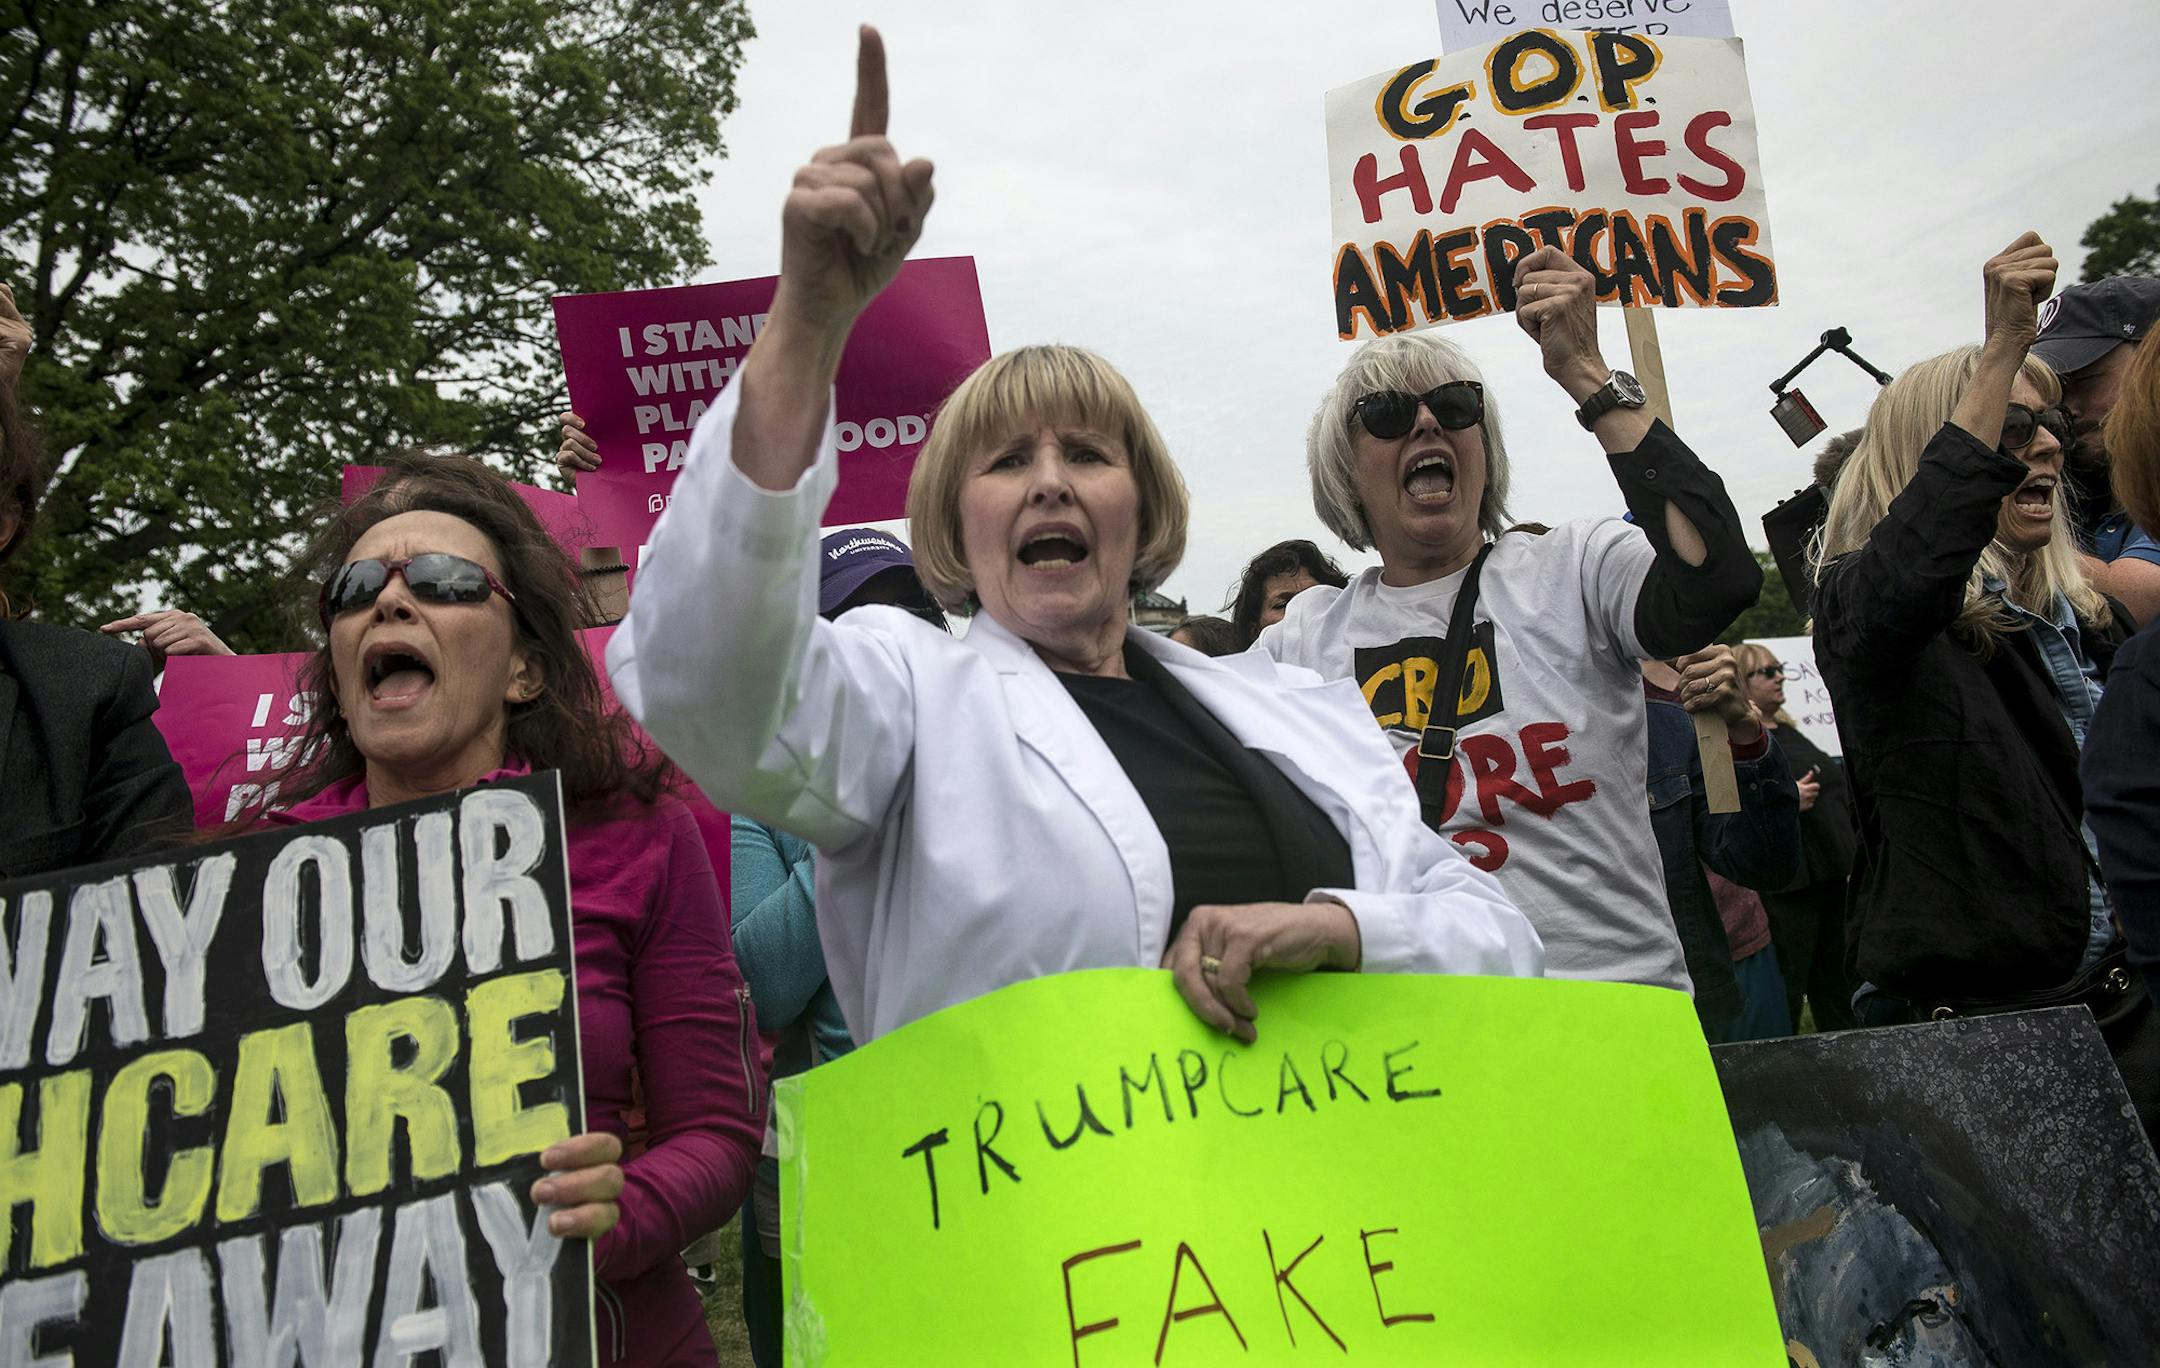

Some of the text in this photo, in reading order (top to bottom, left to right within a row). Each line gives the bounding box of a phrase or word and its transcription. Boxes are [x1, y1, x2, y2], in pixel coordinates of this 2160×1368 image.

[1456, 0, 1693, 25] We deserve
[1353, 110, 1746, 224] HATES
[619, 327, 634, 358] I
[626, 357, 738, 396] WITH
[634, 399, 709, 435] PLA
[642, 415, 927, 473] PA OOD
[828, 537, 904, 560] Northwestern
[251, 691, 319, 728] I S
[1403, 721, 1597, 827] ORE
[262, 788, 555, 1011] OUR
[902, 1040, 1441, 1230] TRUMPCARE
[1062, 1228, 1435, 1368] FAKE
